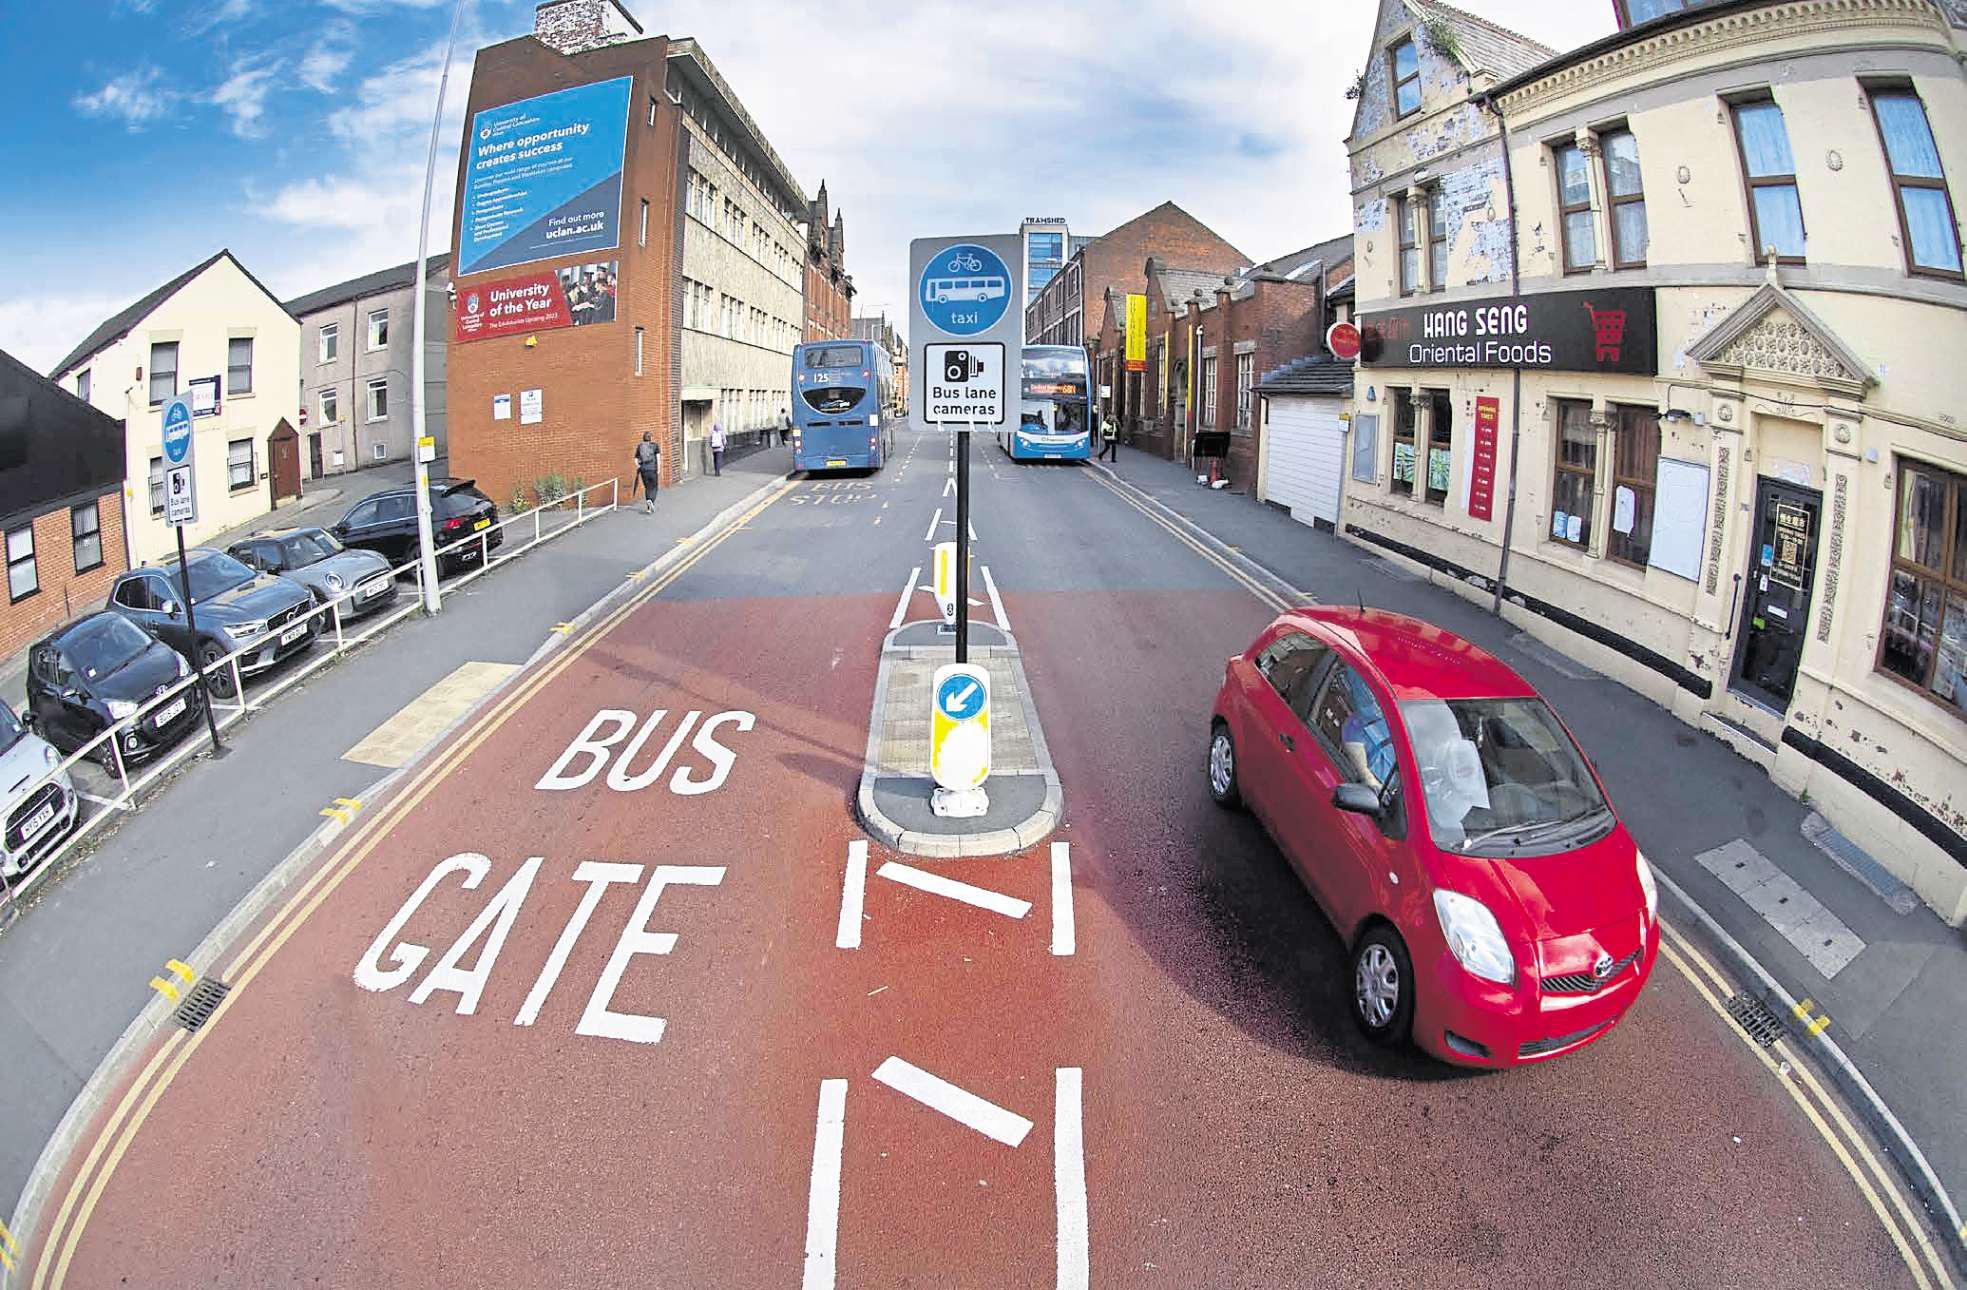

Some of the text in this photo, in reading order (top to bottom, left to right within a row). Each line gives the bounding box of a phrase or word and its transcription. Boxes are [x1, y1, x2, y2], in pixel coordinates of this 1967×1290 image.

[477, 123, 590, 156] Where opportunity
[475, 153, 516, 169] creates
[517, 141, 563, 159] success
[548, 210, 605, 226] Find out more
[545, 221, 604, 240] uclan.ac.uk
[490, 283, 550, 301] University
[489, 299, 552, 317] of the Year
[951, 312, 978, 324] taxi
[1423, 310, 1468, 338] HANG
[1475, 305, 1528, 335] SENG
[1409, 340, 1552, 363] Oriental Foods
[814, 373, 829, 384] 125
[933, 387, 997, 398] Bus lane
[933, 405, 995, 415] cameras
[534, 709, 756, 795] BUS
[353, 852, 727, 1044] GATE
